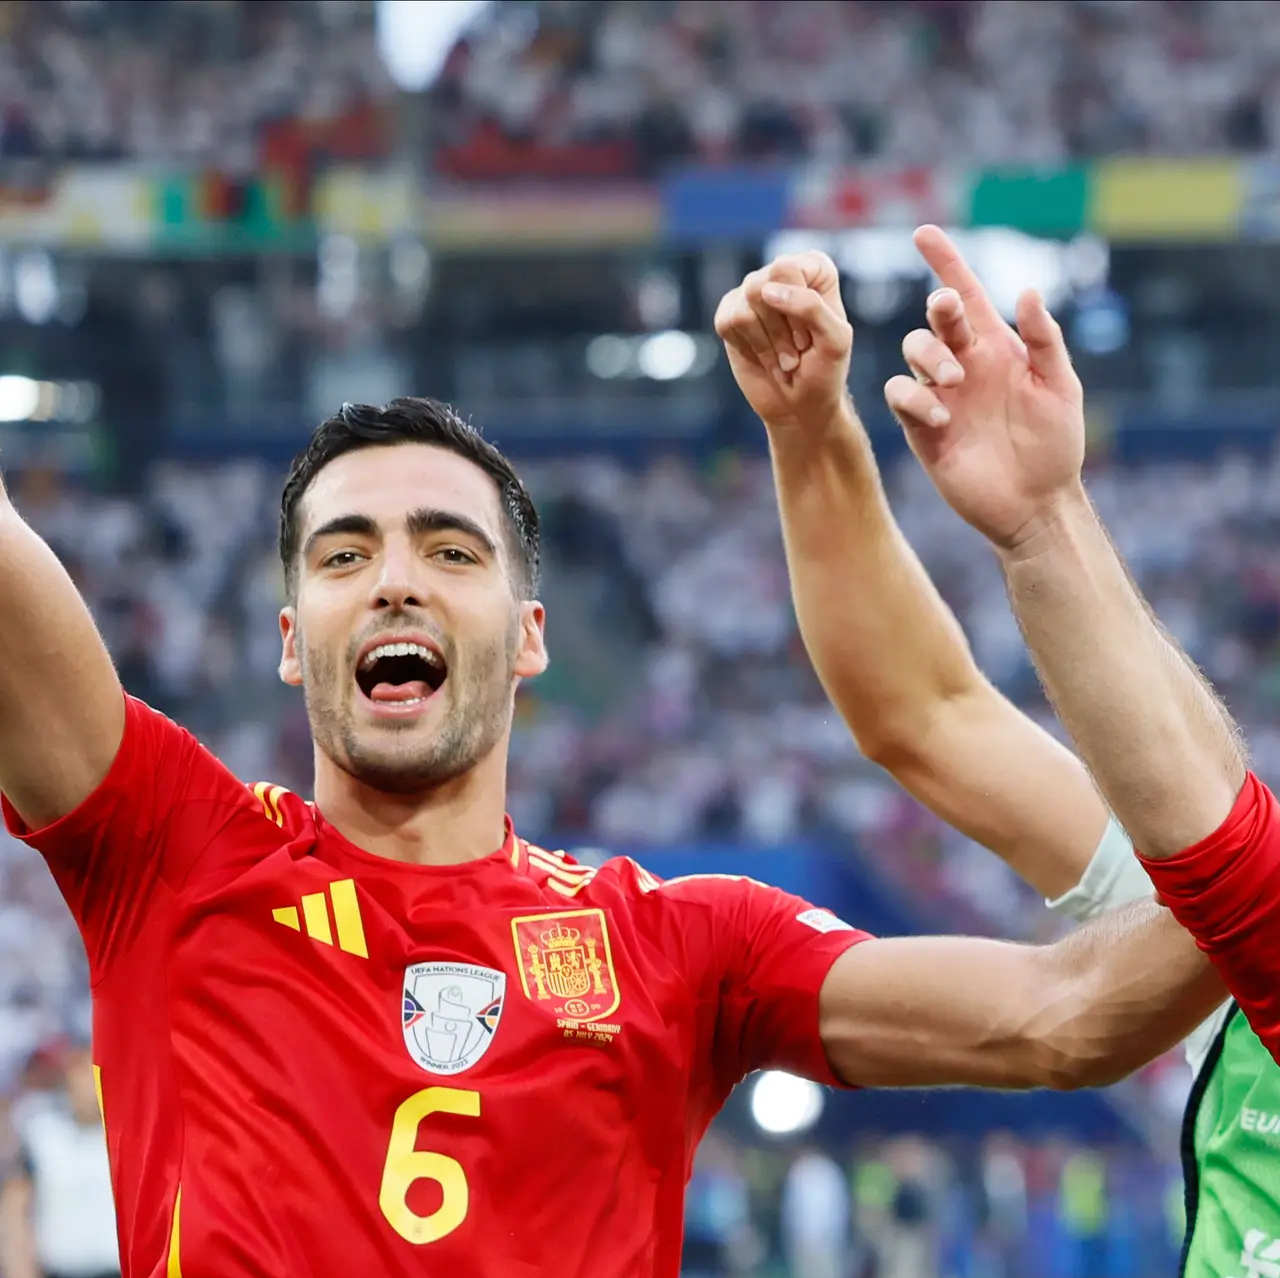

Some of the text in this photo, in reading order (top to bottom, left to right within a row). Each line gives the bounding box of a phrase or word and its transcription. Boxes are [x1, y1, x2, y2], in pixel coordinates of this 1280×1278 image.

[411, 966, 500, 981] UEFA NATIONS LEAGUE
[379, 1087, 481, 1244] 6
